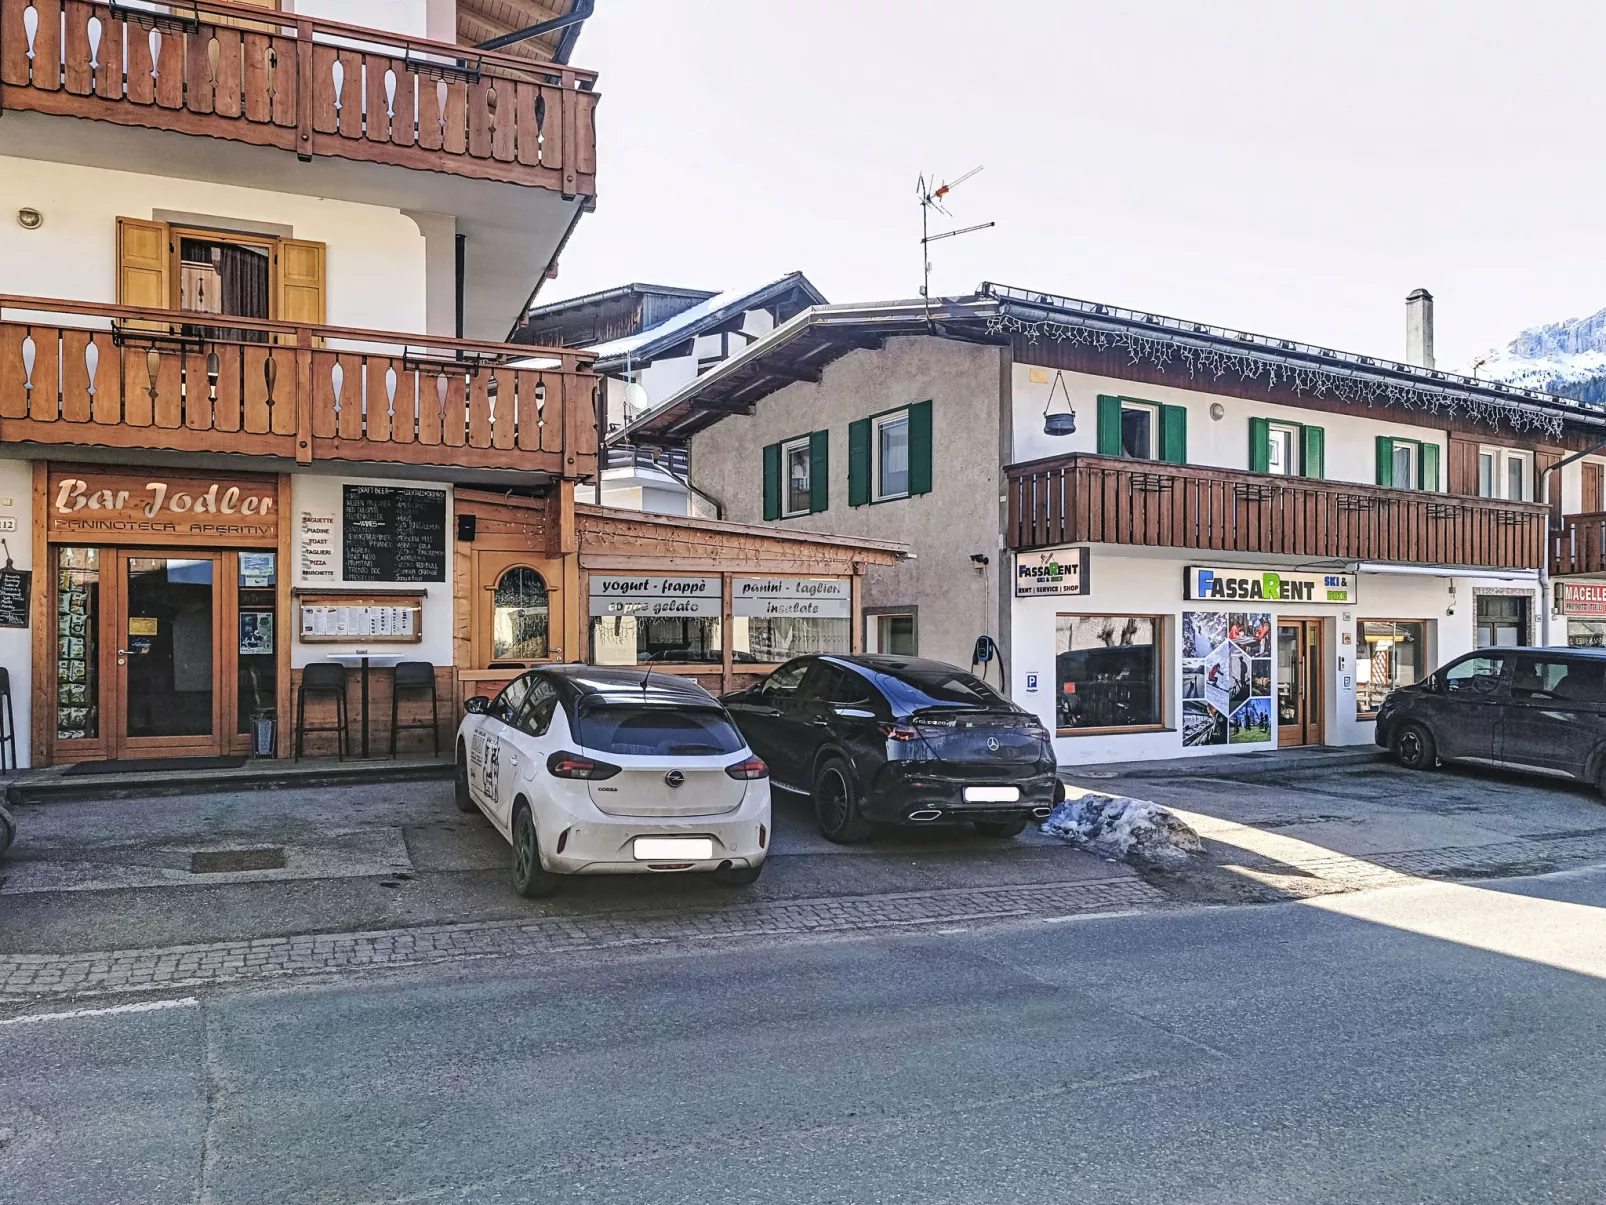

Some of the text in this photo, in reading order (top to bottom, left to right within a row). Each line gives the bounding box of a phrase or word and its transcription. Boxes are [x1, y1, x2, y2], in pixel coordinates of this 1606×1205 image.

[56, 478, 273, 518] Bar Jodler
[54, 519, 275, 535] PANINOTECA APERITIVI
[1019, 562, 1078, 577] FASSARENT
[602, 578, 649, 593] yogurt
[661, 578, 706, 595] frappè
[742, 581, 782, 594] panini
[795, 581, 841, 597] taglieri
[1198, 569, 1315, 600] FASSARENT
[1324, 576, 1347, 587] SKI &
[608, 601, 699, 615] coppe gelato
[766, 601, 819, 614] insalate
